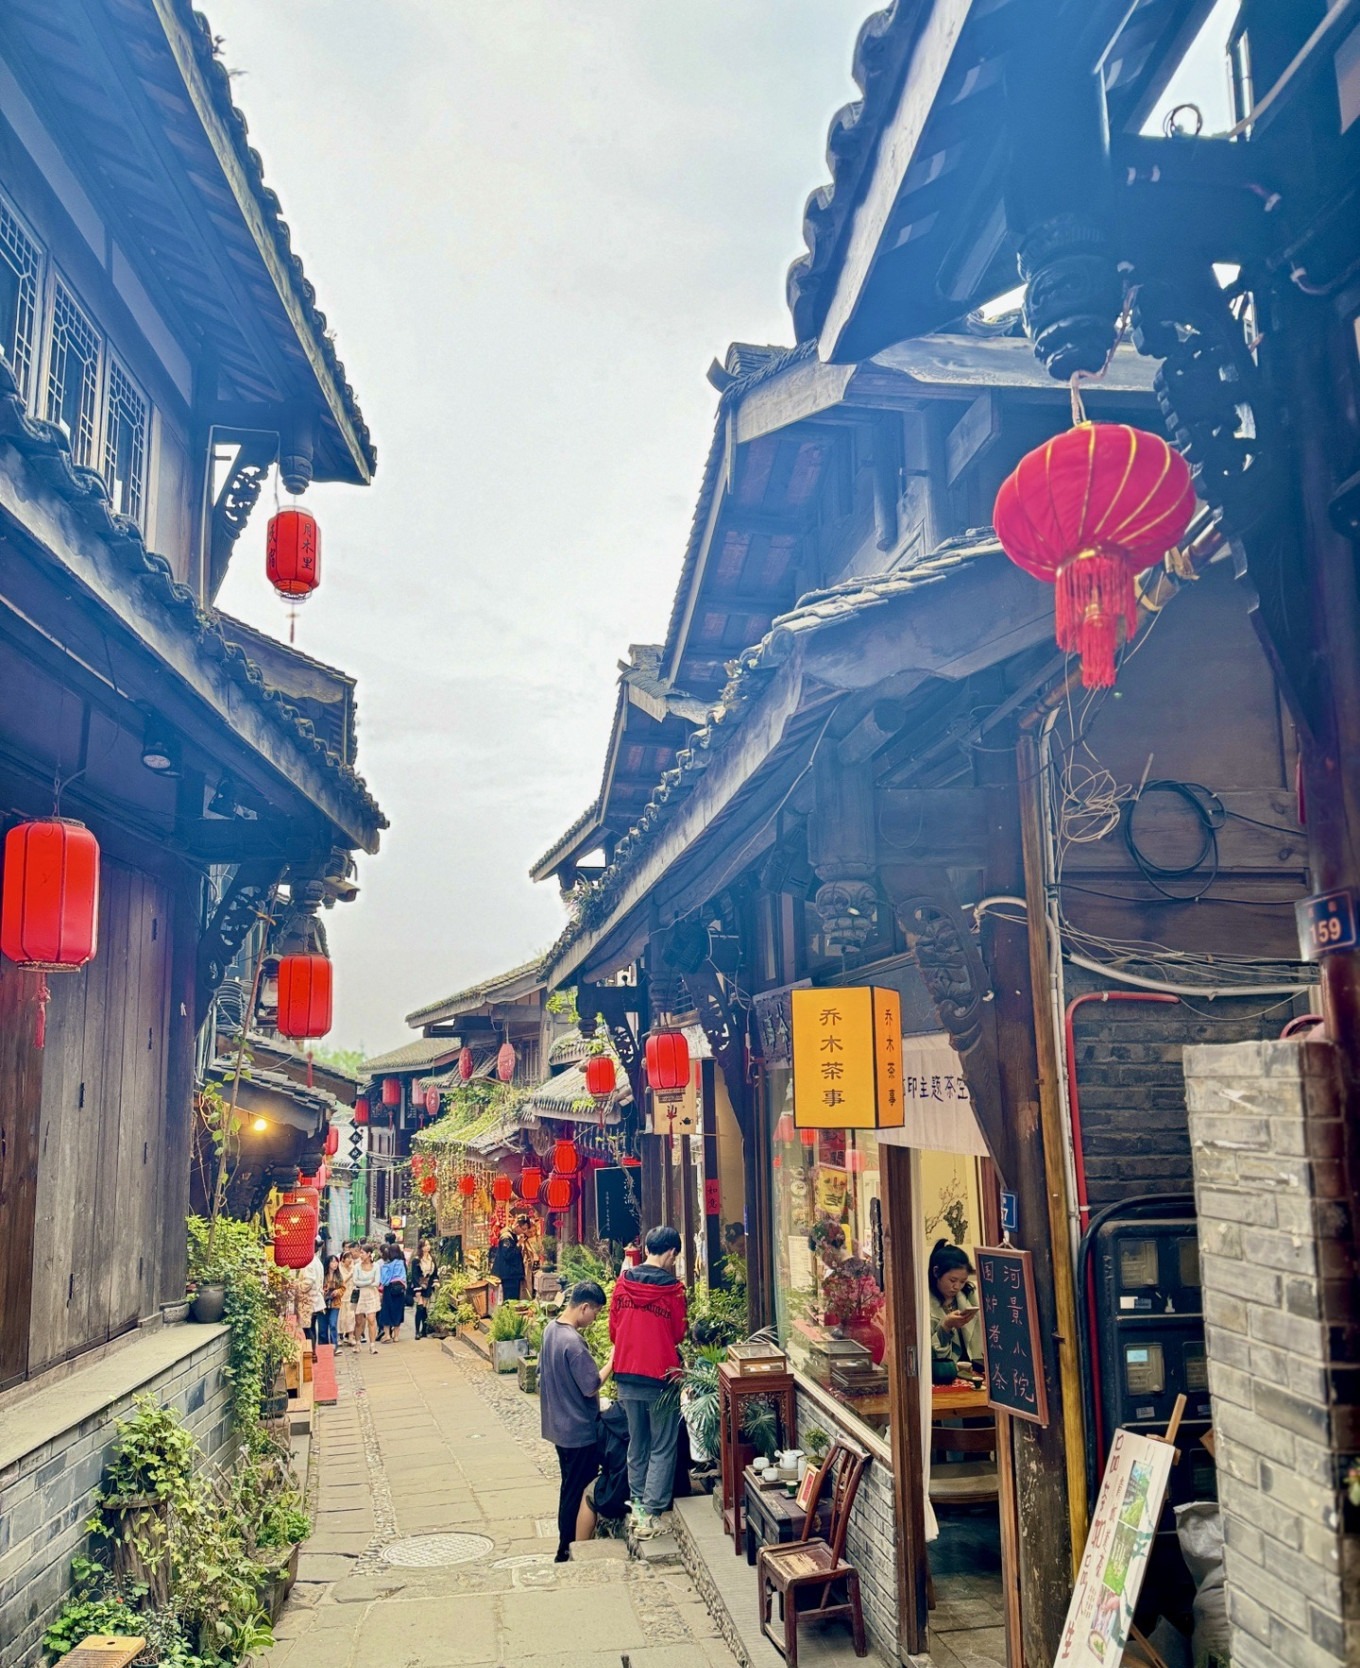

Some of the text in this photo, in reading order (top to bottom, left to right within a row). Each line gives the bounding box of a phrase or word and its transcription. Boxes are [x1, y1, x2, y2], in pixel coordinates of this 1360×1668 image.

[1310, 917, 1341, 944] 159
[819, 1007, 846, 1108] 乔木茶事
[884, 1008, 896, 1107] 乔木茶事
[902, 1075, 969, 1102] 印主题茶空
[1003, 1265, 1035, 1403] 河景小院
